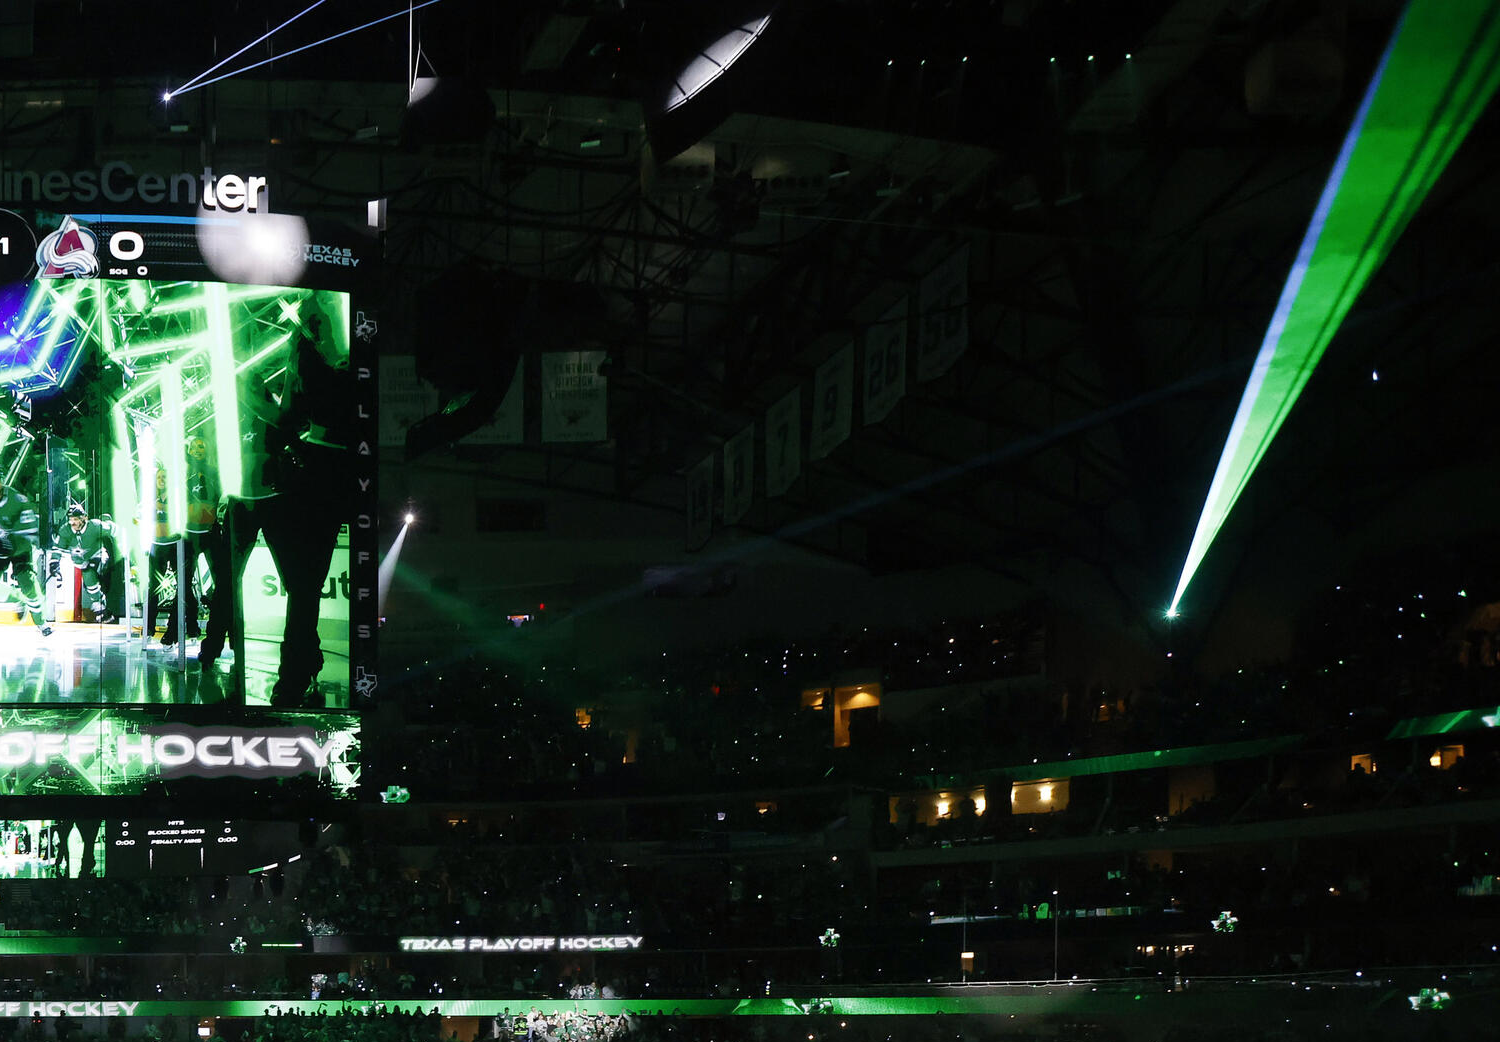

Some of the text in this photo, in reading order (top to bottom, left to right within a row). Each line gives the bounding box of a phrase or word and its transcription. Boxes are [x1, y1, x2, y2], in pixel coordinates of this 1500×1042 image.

[108, 230, 145, 261] 0
[303, 243, 352, 257] TEXAS
[303, 253, 360, 267] HOCKEY
[107, 730, 336, 771] HOCKEY
[401, 935, 644, 951] TEXAS PLAYOFF HOCKEY
[27, 1001, 140, 1017] HOCKEY
